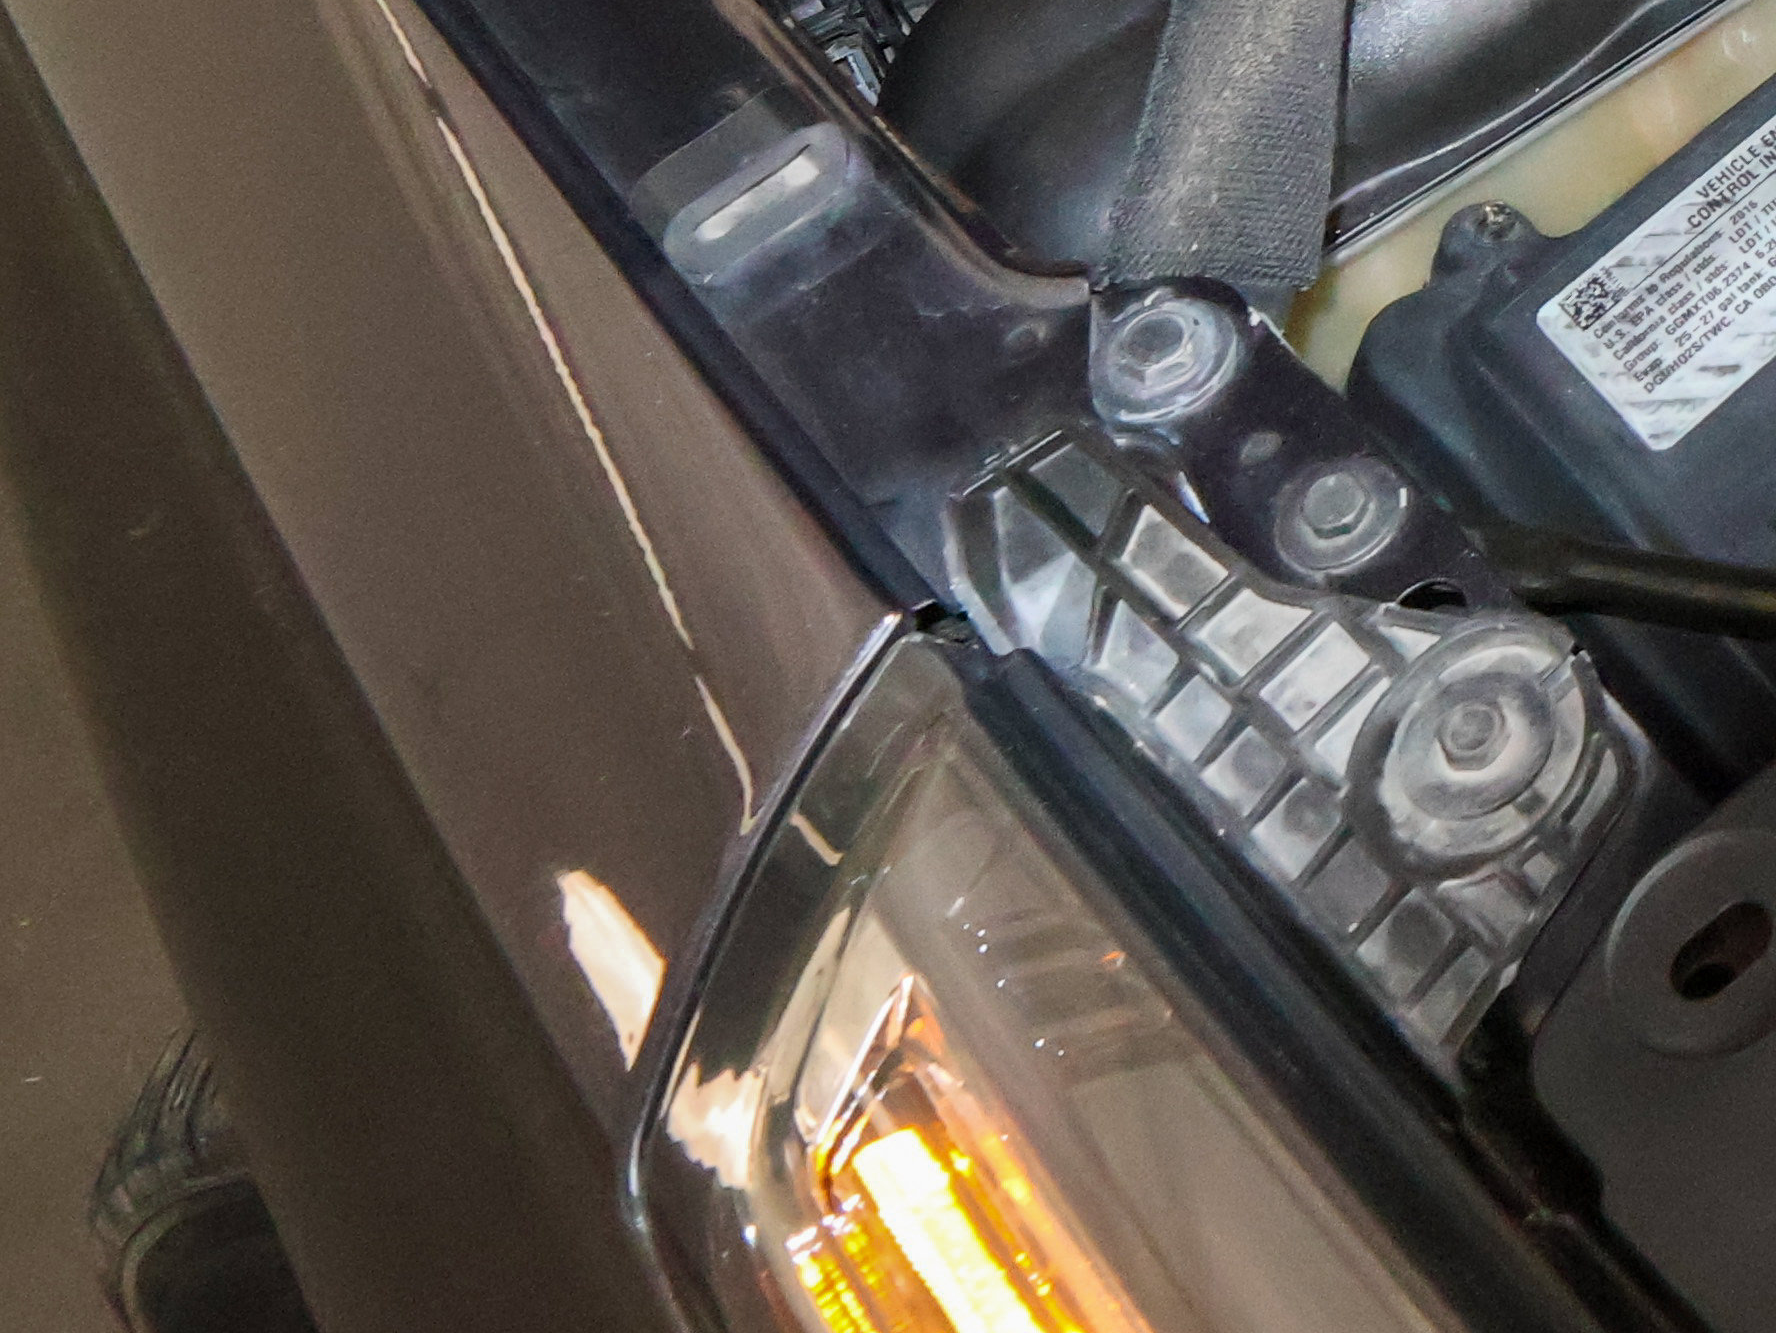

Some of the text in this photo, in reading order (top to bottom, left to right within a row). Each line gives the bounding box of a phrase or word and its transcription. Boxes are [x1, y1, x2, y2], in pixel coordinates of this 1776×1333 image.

[1686, 165, 1760, 230] CONTROL
[1696, 144, 1761, 202] VEHICLE
[1592, 292, 1646, 340] Conforms
[1644, 280, 1660, 296] to
[1602, 324, 1630, 350] U.S.
[1628, 303, 1655, 328] EPA
[1653, 279, 1684, 307] class
[1728, 220, 1753, 244] LDT
[1612, 312, 1668, 361] California
[1665, 287, 1696, 315] class
[1738, 230, 1764, 254] LDT
[1716, 290, 1739, 313] gal
[1733, 296, 1754, 316] CA
